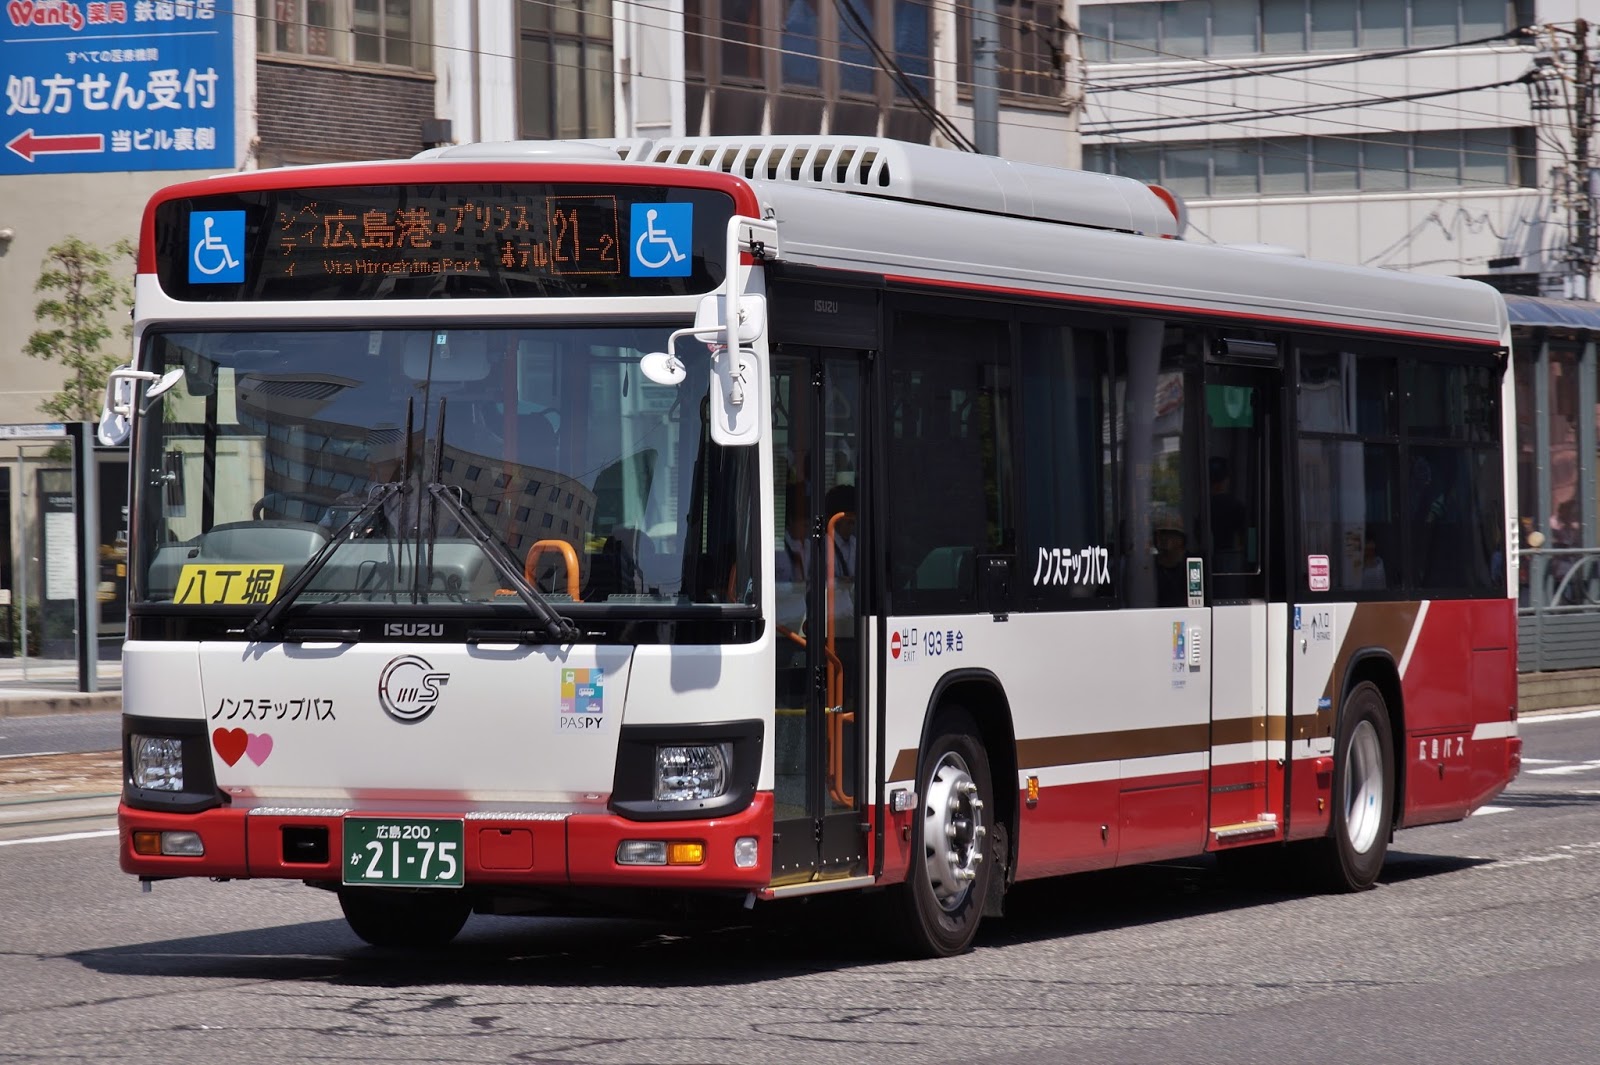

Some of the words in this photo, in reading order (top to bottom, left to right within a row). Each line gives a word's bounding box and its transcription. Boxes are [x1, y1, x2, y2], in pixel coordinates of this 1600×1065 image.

[8, 0, 85, 31] Wants
[87, 3, 128, 25] 薬局
[66, 48, 159, 64] すべての医療機関
[5, 67, 219, 116] 処方せん受付
[111, 127, 216, 152] 当ビル裏側
[501, 241, 548, 268] ホテル
[814, 299, 838, 314] ISUZU
[1033, 545, 1111, 586] ノンステップバス
[179, 569, 275, 605] 八丁堀
[384, 623, 444, 636] ISUZU
[902, 627, 918, 648] 出口
[903, 650, 916, 662] EXIT
[923, 630, 943, 657] 193
[946, 630, 964, 652] 乗合
[211, 697, 336, 721] ノンステップバス
[560, 716, 603, 729] PASPY
[1418, 736, 1465, 761] 広島バス
[350, 852, 363, 866] か
[365, 840, 457, 880] 21-75
